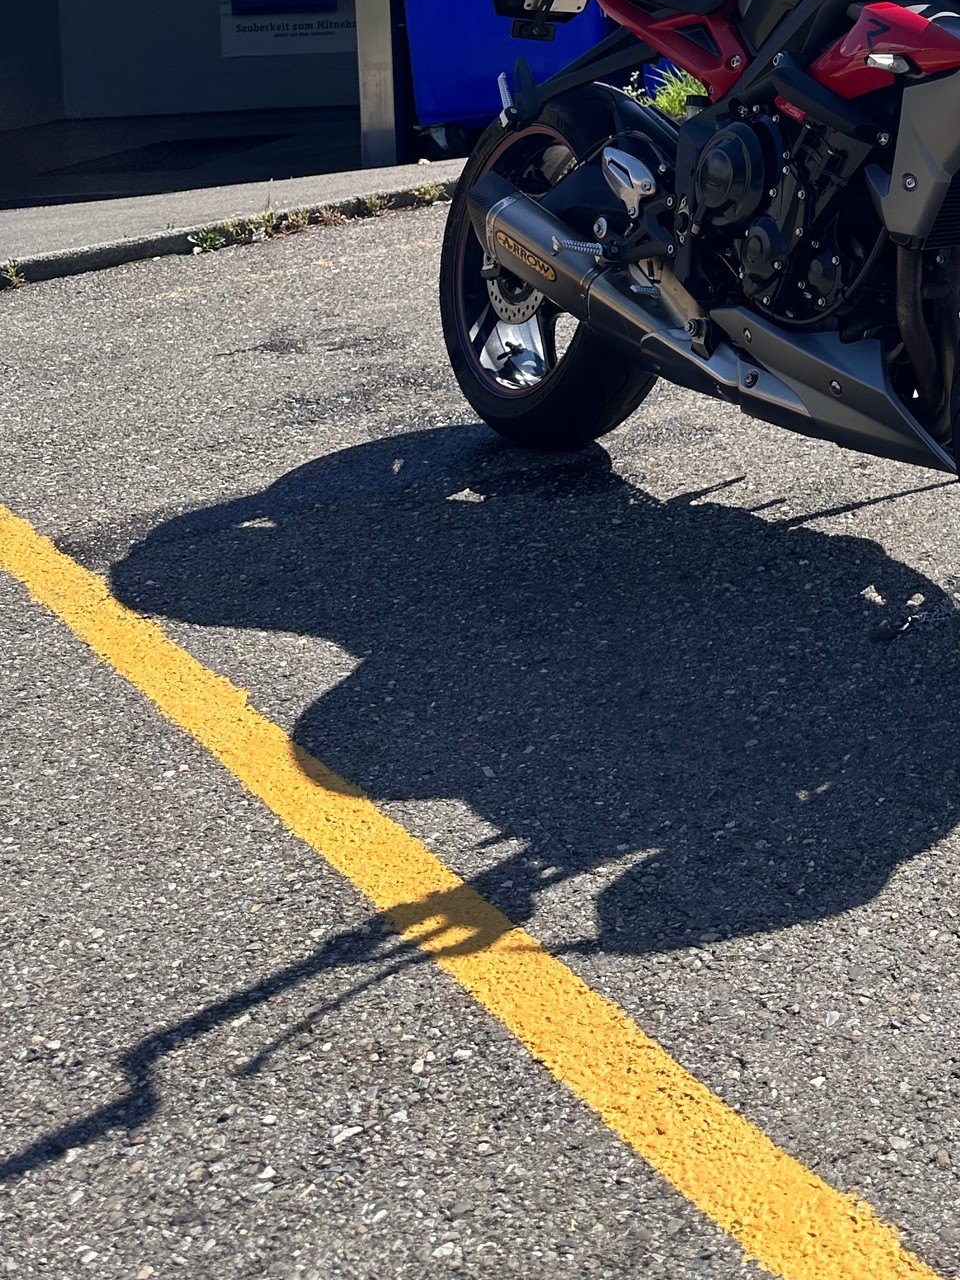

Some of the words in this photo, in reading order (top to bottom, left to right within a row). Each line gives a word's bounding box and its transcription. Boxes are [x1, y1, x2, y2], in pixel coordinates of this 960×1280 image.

[235, 22, 290, 33] Sauberkeit
[292, 23, 314, 31] zum
[501, 236, 551, 275] ARROW
